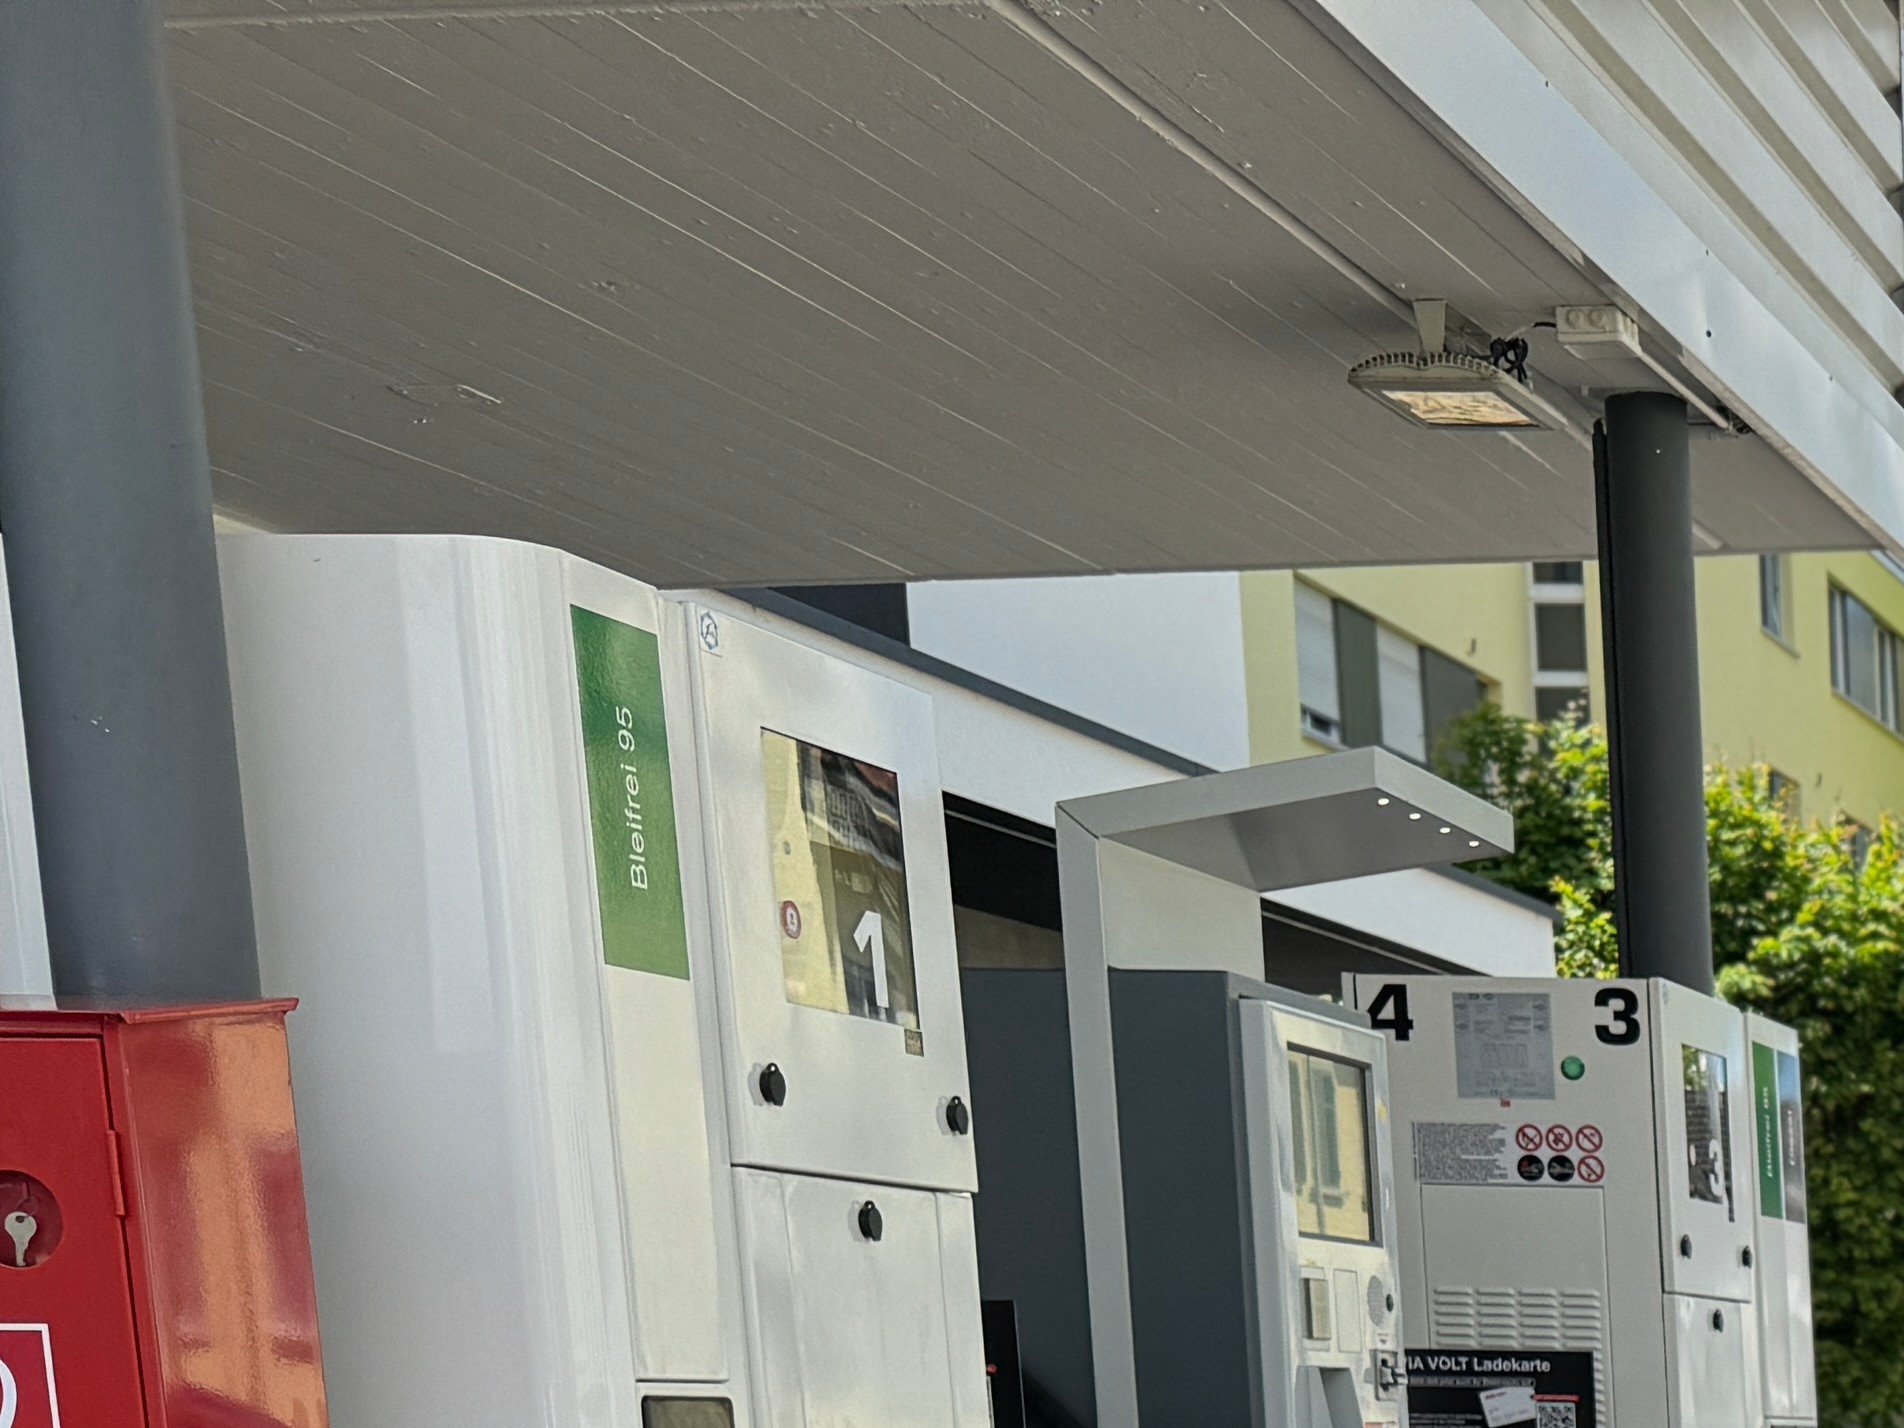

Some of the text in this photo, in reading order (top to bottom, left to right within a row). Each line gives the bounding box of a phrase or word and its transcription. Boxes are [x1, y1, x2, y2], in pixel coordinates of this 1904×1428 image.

[615, 706, 648, 890] Bleifrei 95
[853, 910, 889, 1008] 1
[1368, 984, 1414, 1041] 4
[1594, 987, 1641, 1046] 3
[1408, 1355, 1551, 1373] IA VOLT Ladekarte
